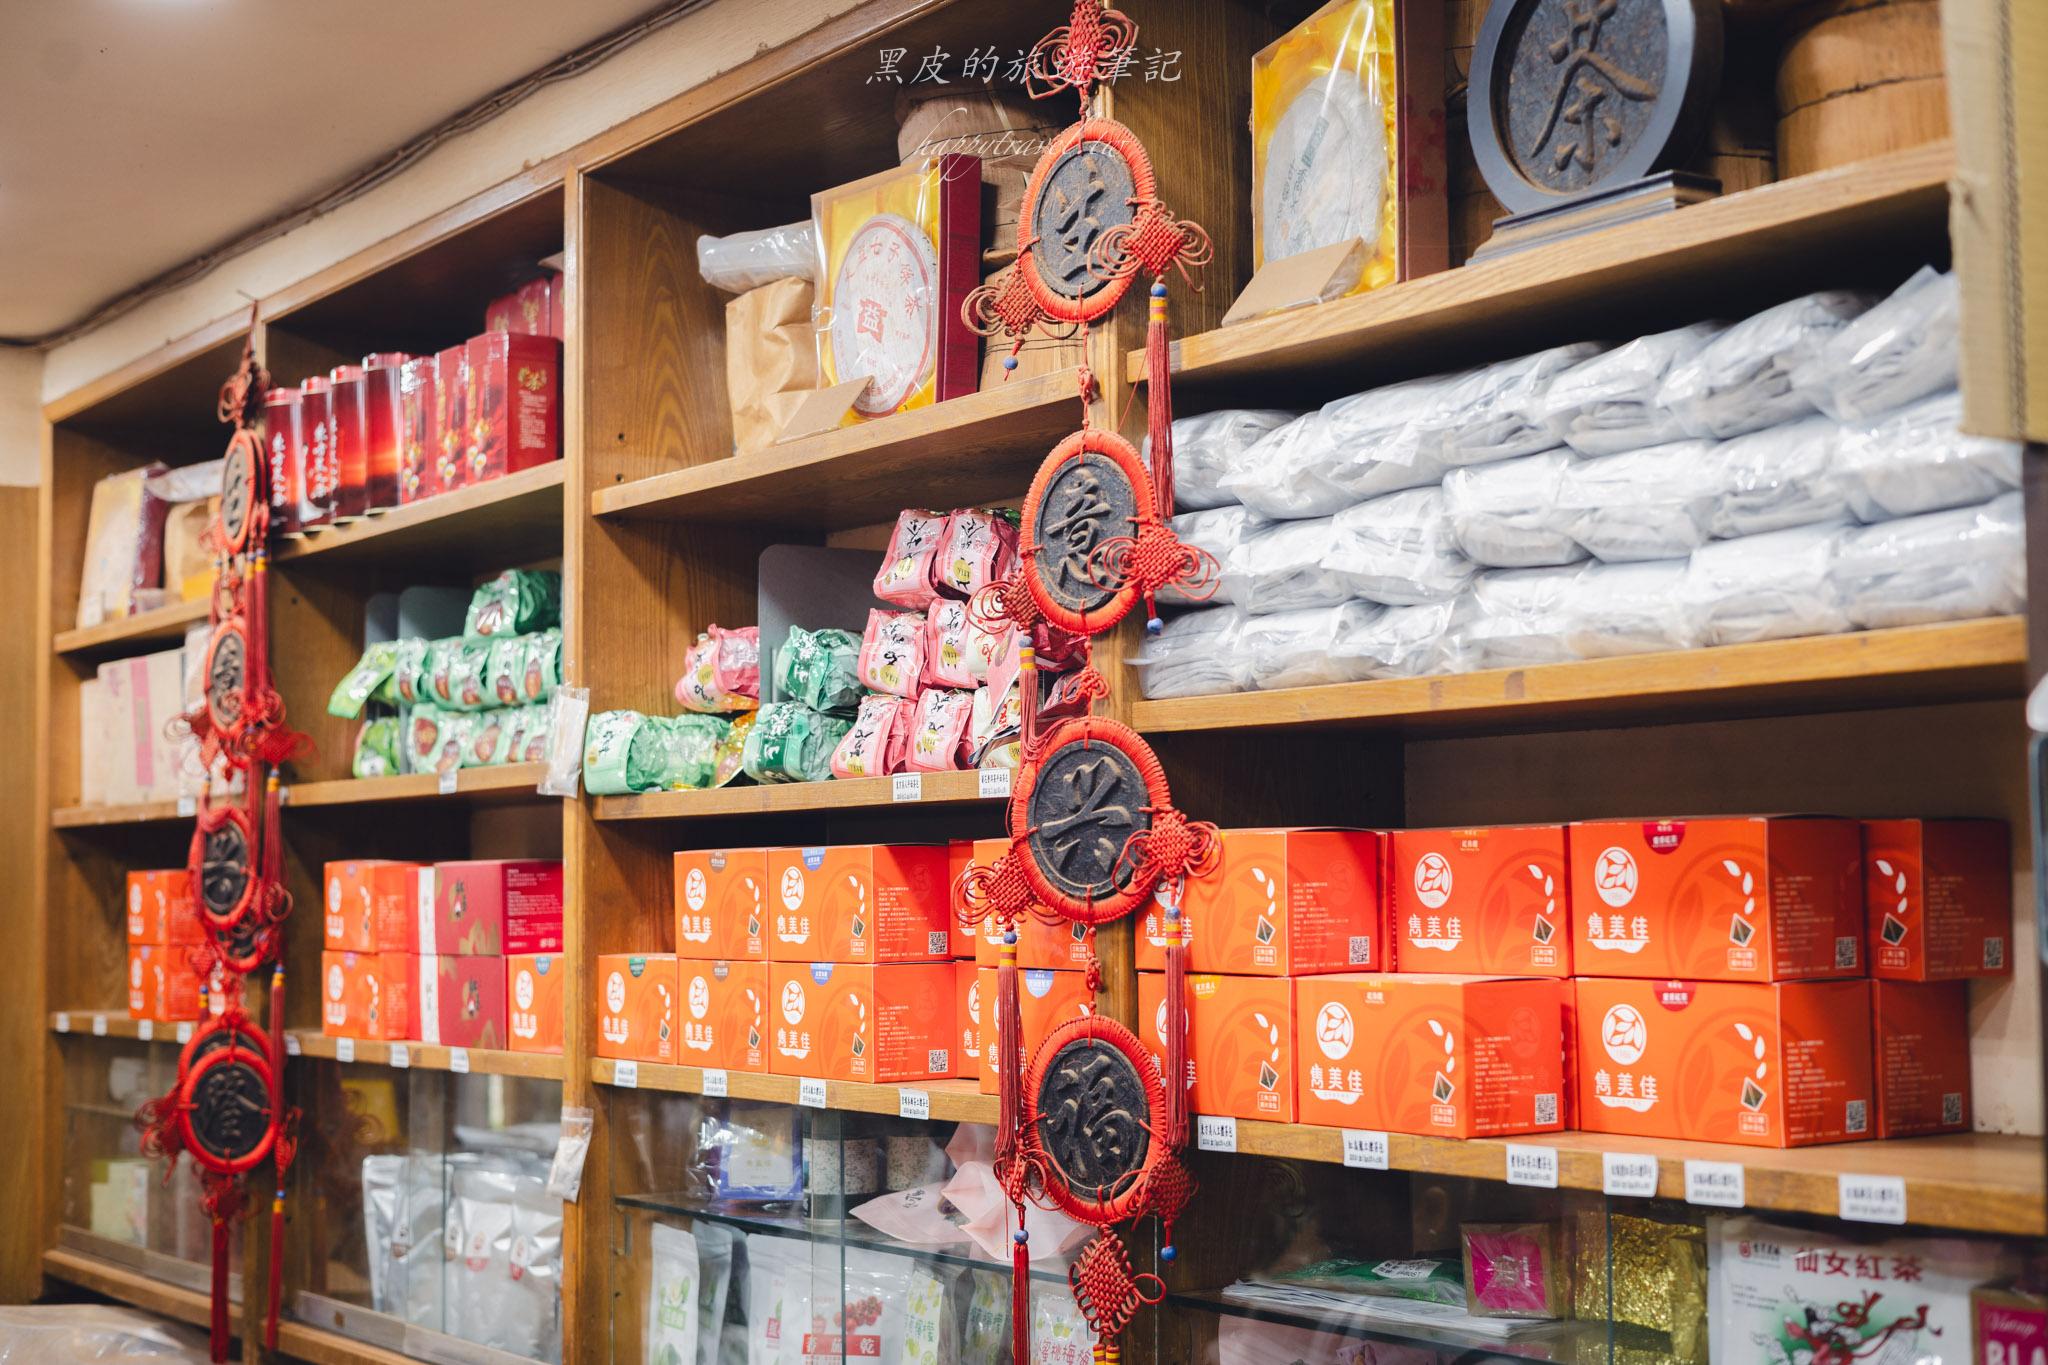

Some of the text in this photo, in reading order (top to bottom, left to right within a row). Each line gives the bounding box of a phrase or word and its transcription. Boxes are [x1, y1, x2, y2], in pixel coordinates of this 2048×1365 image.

[1310, 1064, 1364, 1090] 雋美佳
[1594, 1069, 1657, 1097] 雋美佳
[1795, 1247, 1923, 1282] 仙女紅茶
